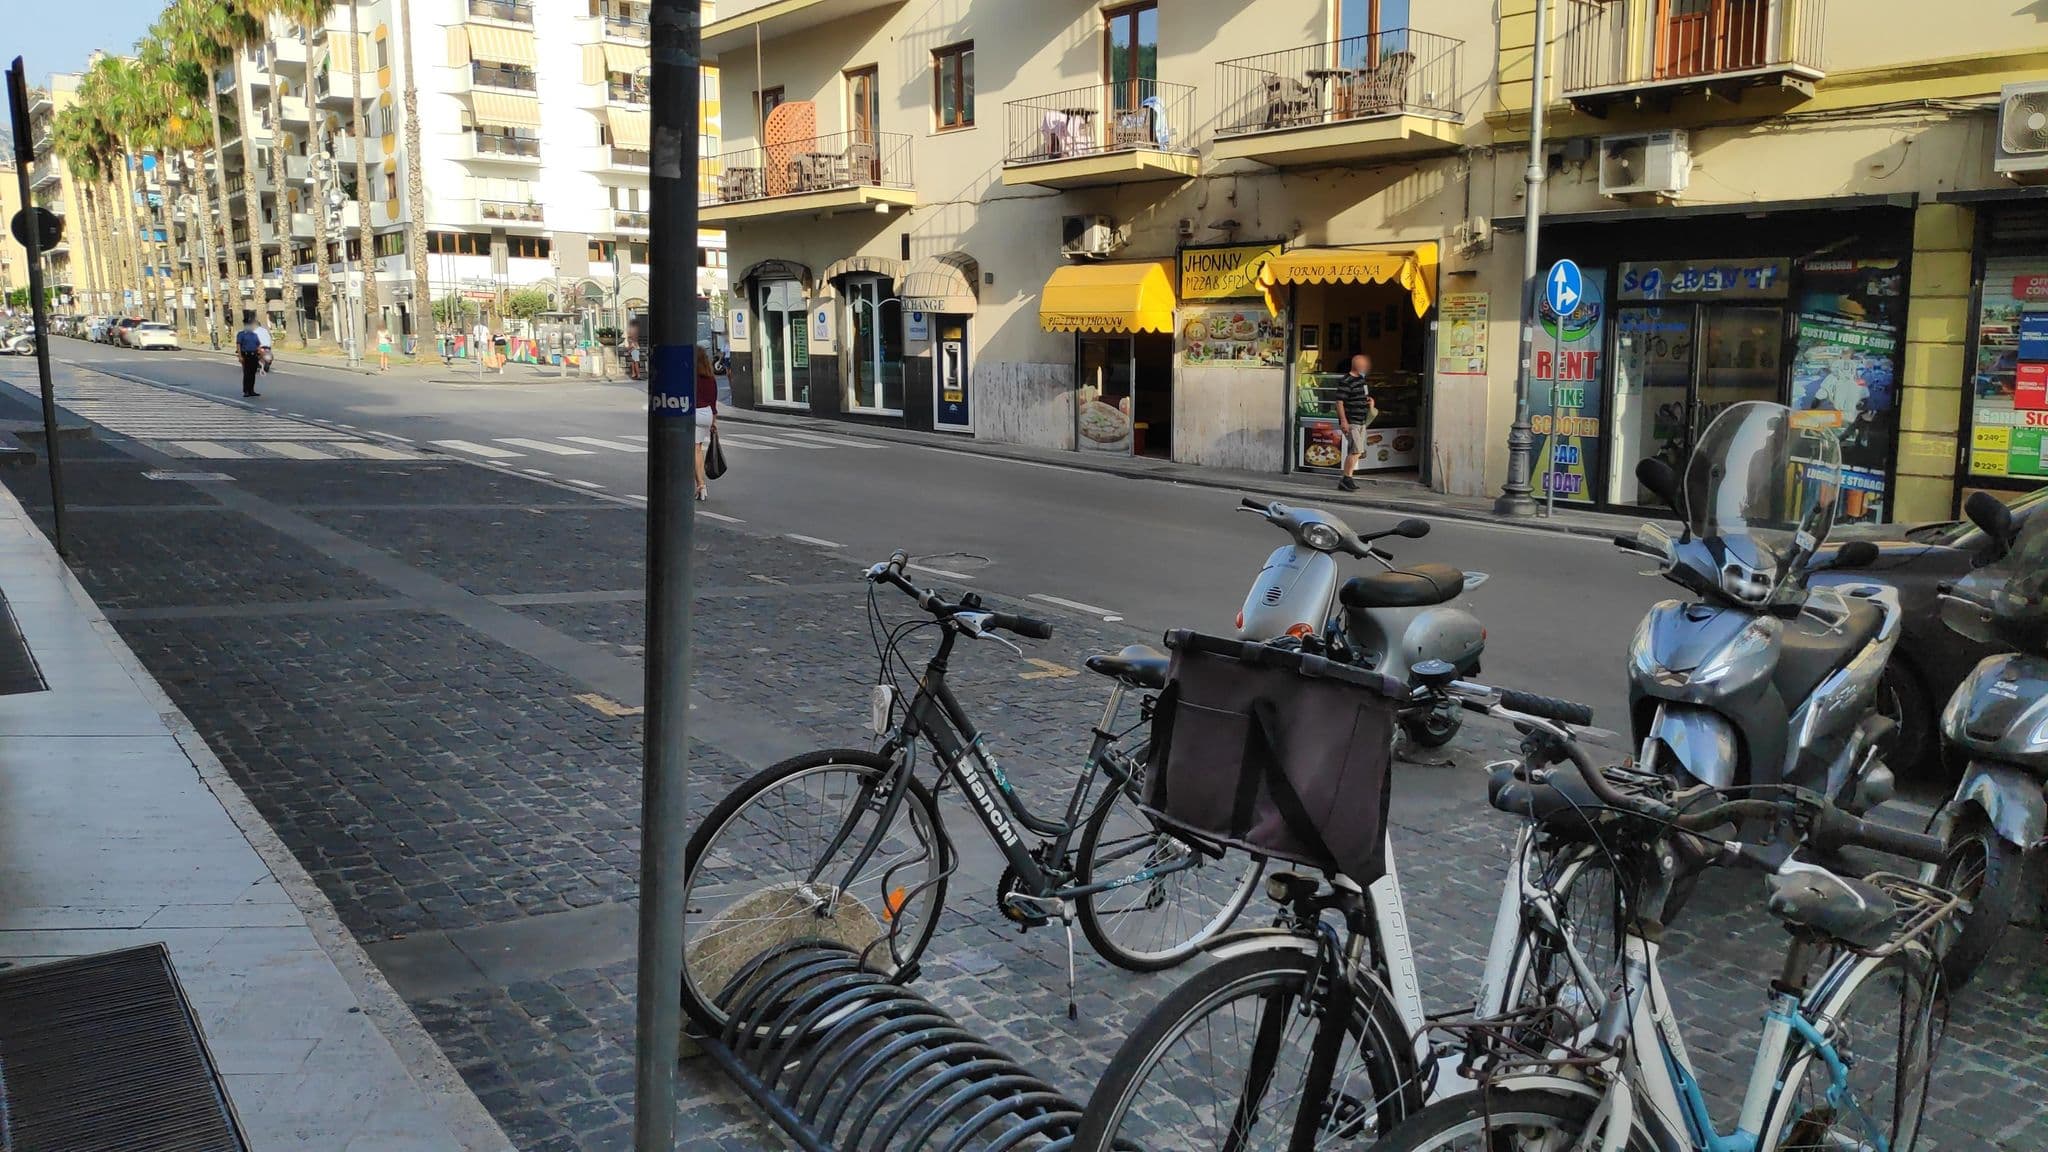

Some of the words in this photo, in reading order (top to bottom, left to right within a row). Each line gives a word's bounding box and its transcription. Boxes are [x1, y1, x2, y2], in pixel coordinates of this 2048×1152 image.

[1185, 253, 1242, 272] JHONNY
[1287, 266, 1325, 278] FORNO
[1328, 266, 1337, 275] A
[1338, 265, 1380, 276] LEGNA
[1186, 276, 1212, 291] PIZZA
[1085, 316, 1123, 327] JHONNY
[1801, 326, 1838, 341] CUSTOM
[1838, 332, 1861, 346] YOUR
[1861, 335, 1896, 350] T-SHIRT
[652, 392, 690, 413] play
[957, 755, 1019, 847] Bianchi
